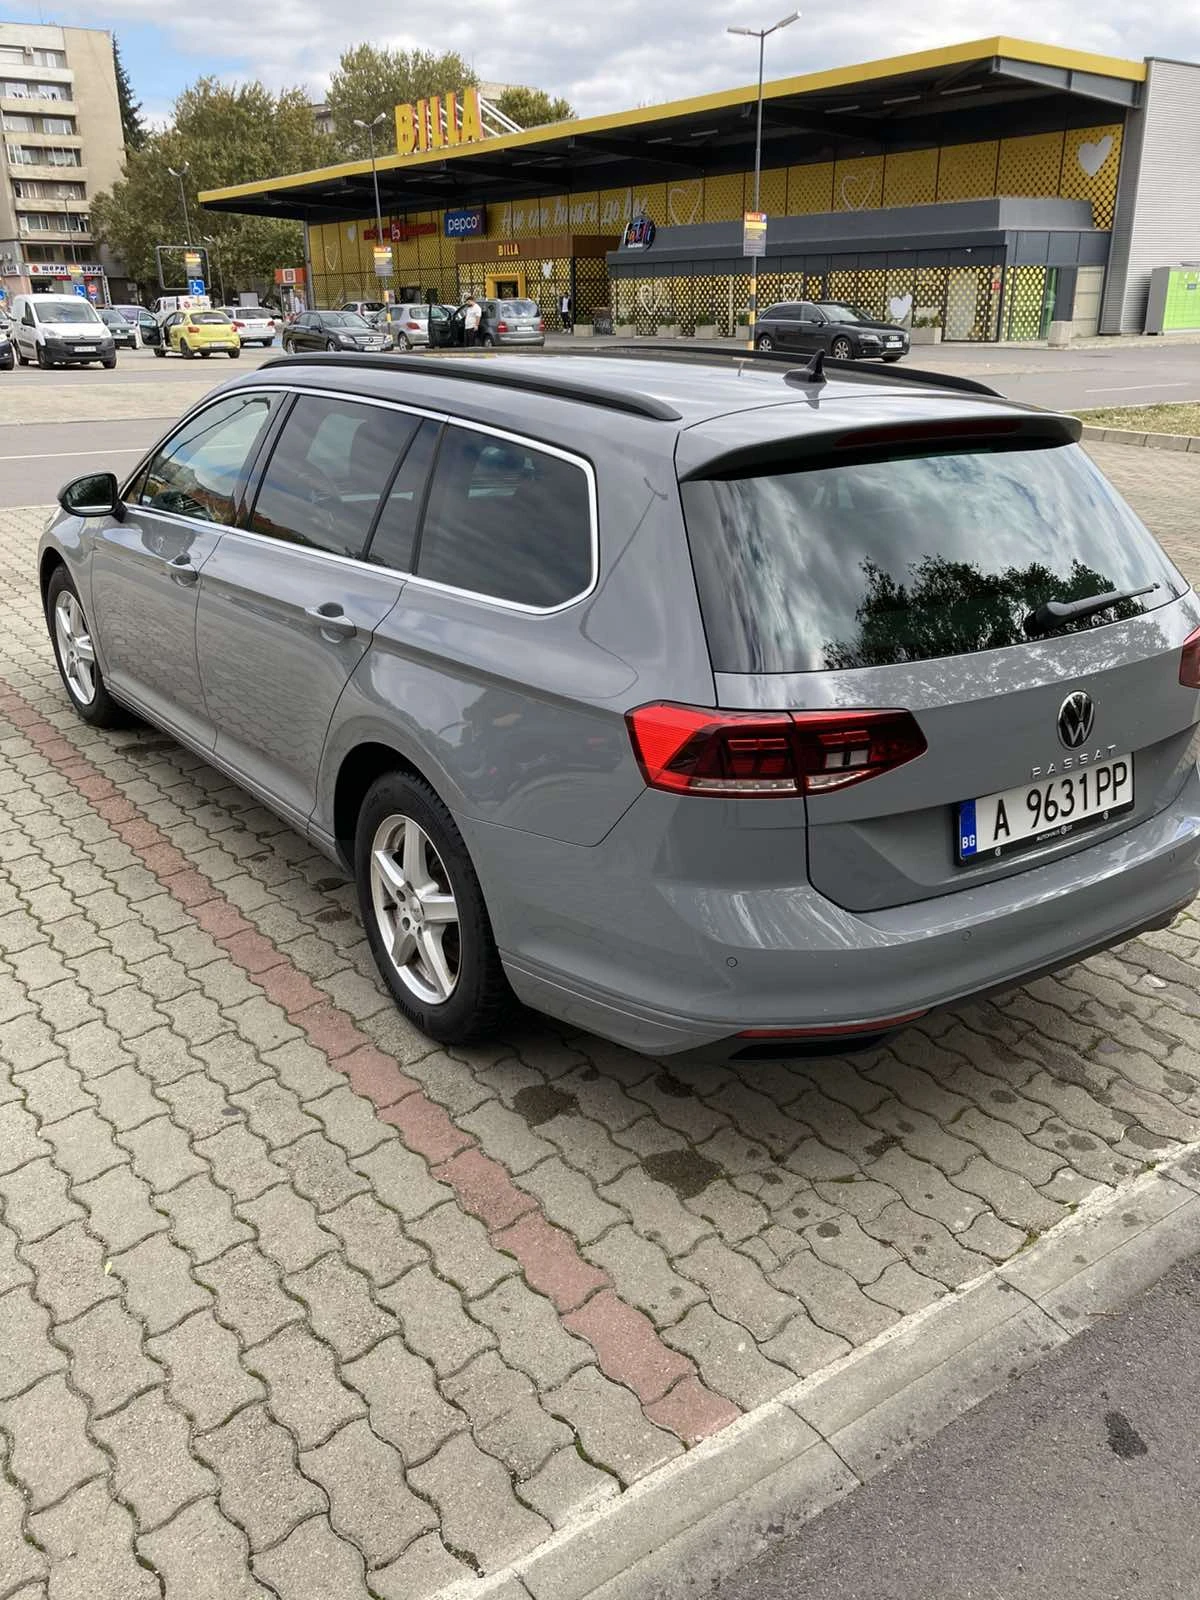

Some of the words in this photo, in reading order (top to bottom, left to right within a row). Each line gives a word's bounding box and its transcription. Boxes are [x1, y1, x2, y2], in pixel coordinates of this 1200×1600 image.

[395, 86, 482, 154] BILLA
[447, 215, 478, 233] pepco
[498, 243, 519, 257] BILLA
[1031, 744, 1117, 779] PASSAT
[993, 798, 1011, 841] A
[961, 835, 976, 849] BG
